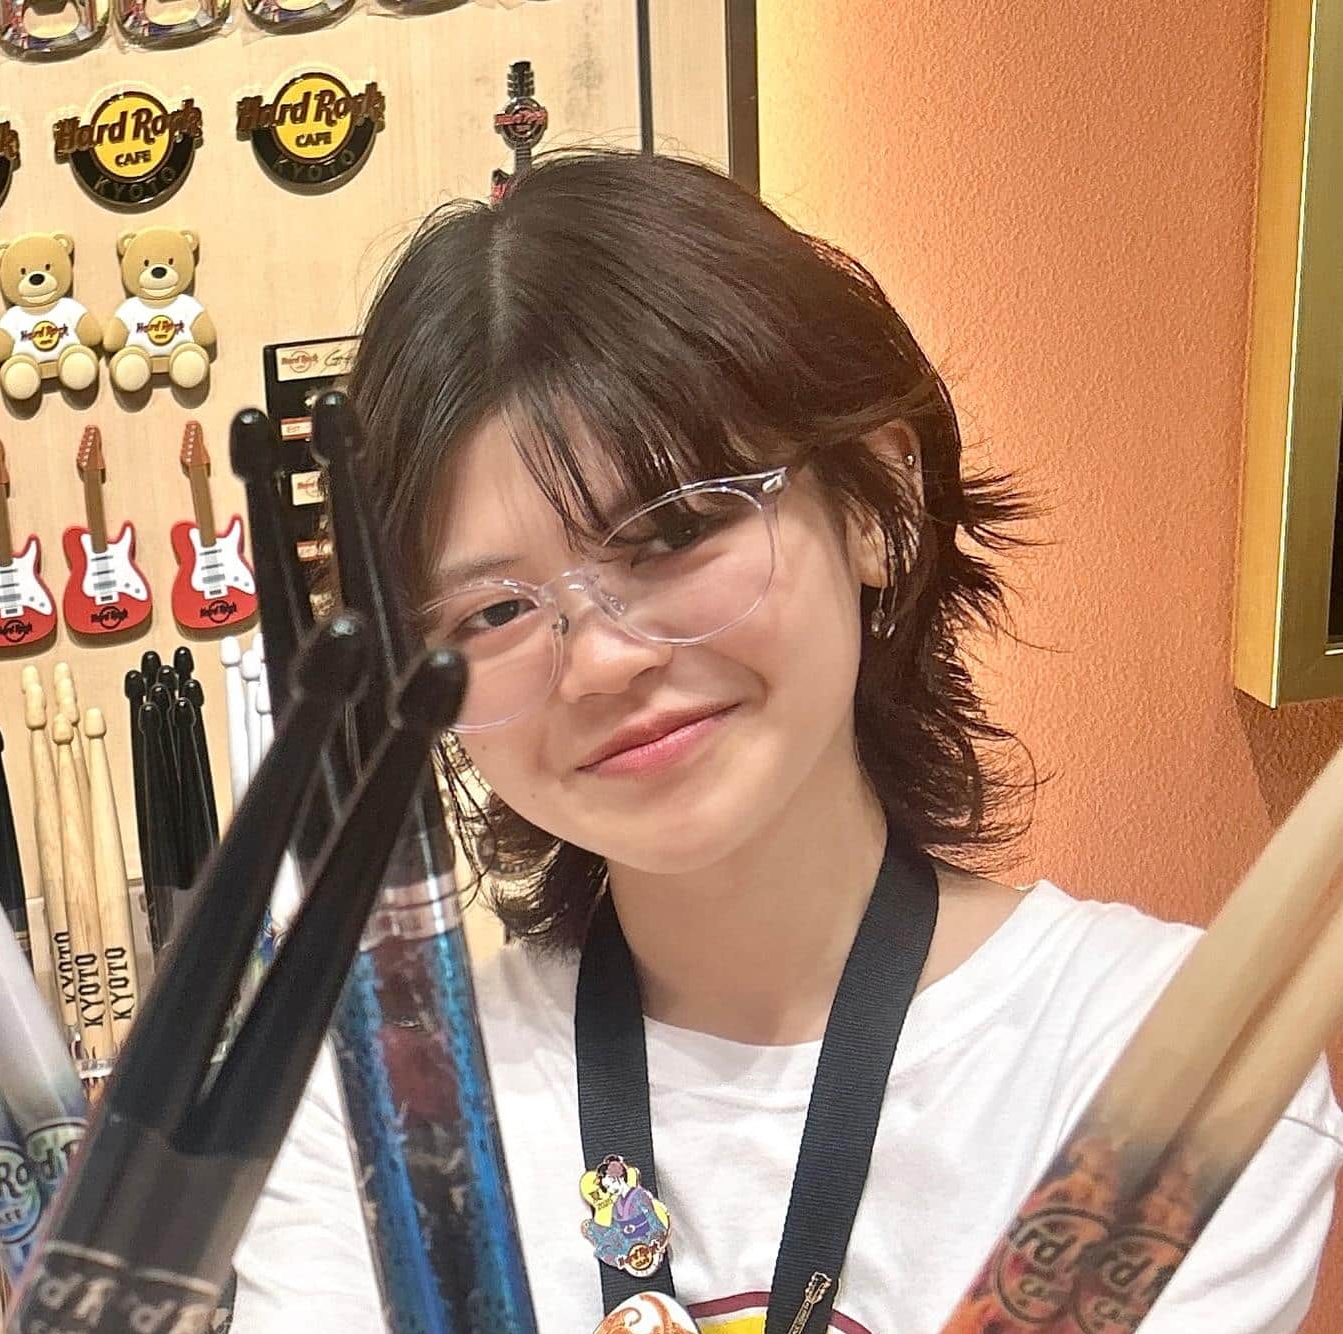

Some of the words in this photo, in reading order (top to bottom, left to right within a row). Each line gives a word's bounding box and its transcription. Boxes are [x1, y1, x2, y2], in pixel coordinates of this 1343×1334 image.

[114, 150, 151, 167] CAFE
[295, 131, 332, 148] CAFE
[75, 953, 105, 1027] KYOTO
[105, 947, 135, 1020] KYOTO
